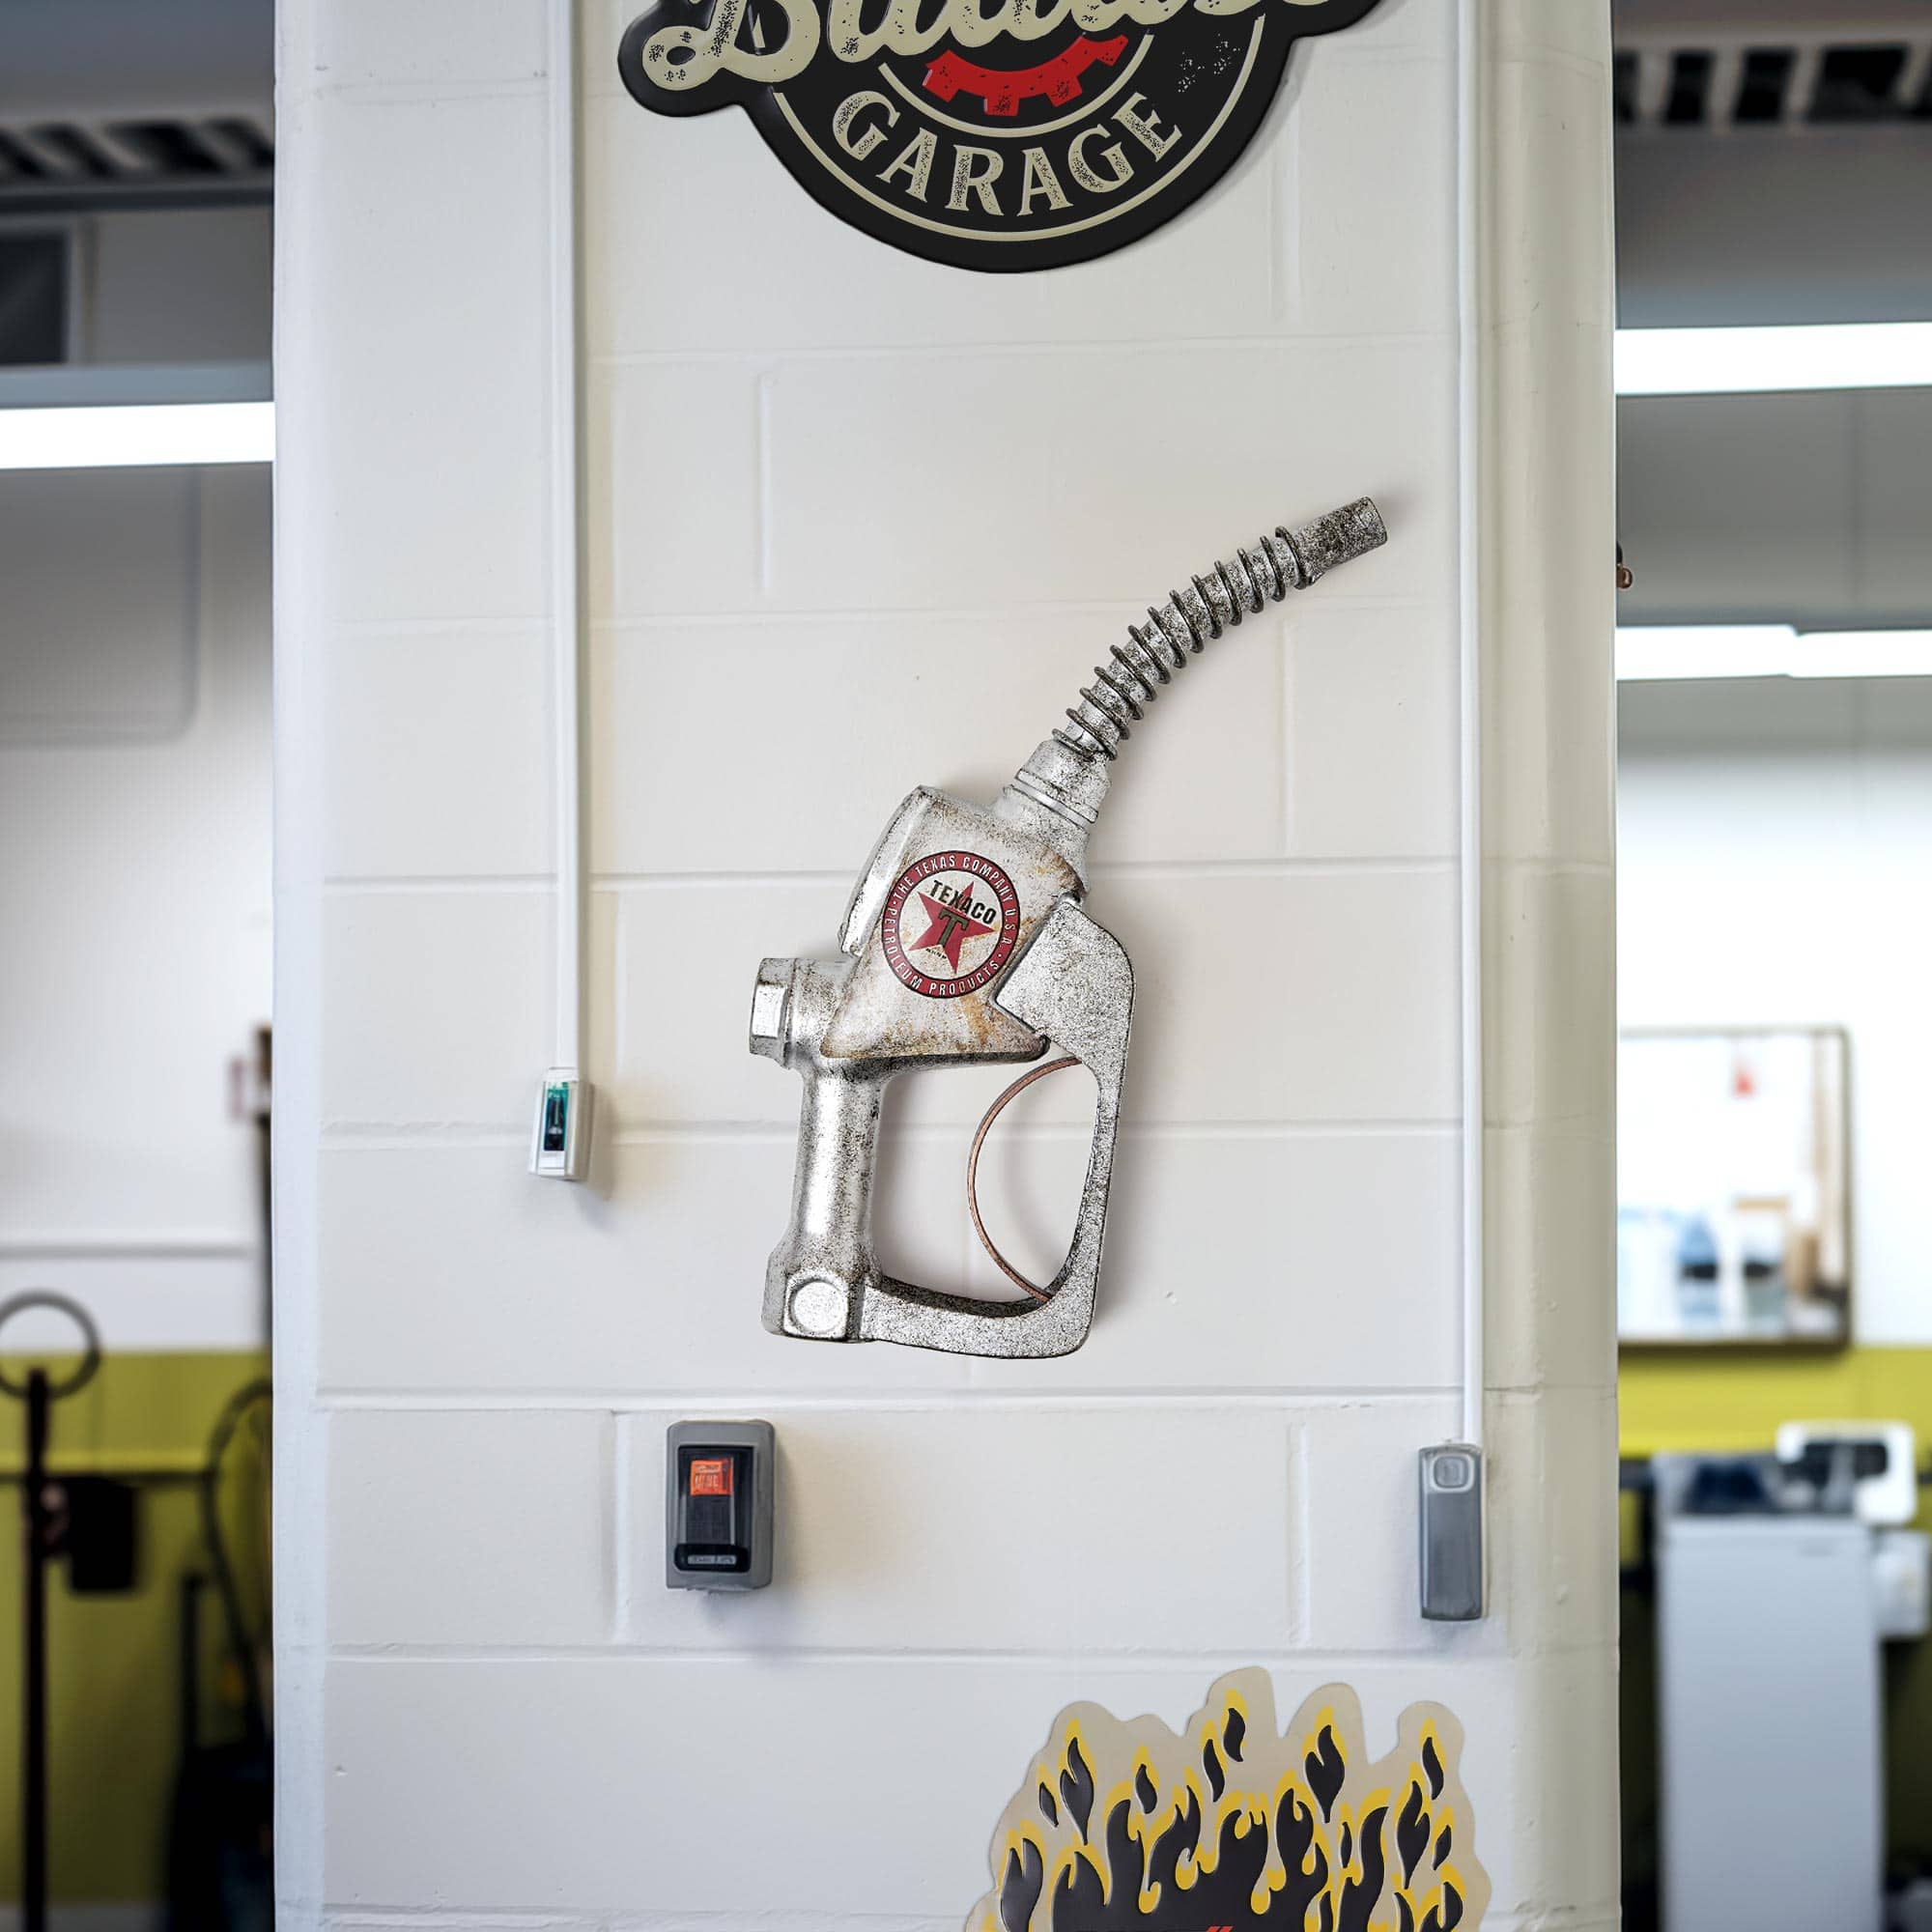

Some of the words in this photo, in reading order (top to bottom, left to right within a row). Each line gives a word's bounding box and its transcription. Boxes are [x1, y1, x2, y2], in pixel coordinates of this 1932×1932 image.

[832, 90, 1182, 217] GARAGE
[894, 876, 913, 899] THE
[916, 855, 955, 877] TEXAS
[963, 857, 1013, 901] COMPANY
[929, 880, 996, 924] TEXACO
[937, 908, 969, 947] T
[885, 908, 922, 989] PETROLEUM
[929, 961, 999, 995] PRODUCTS
